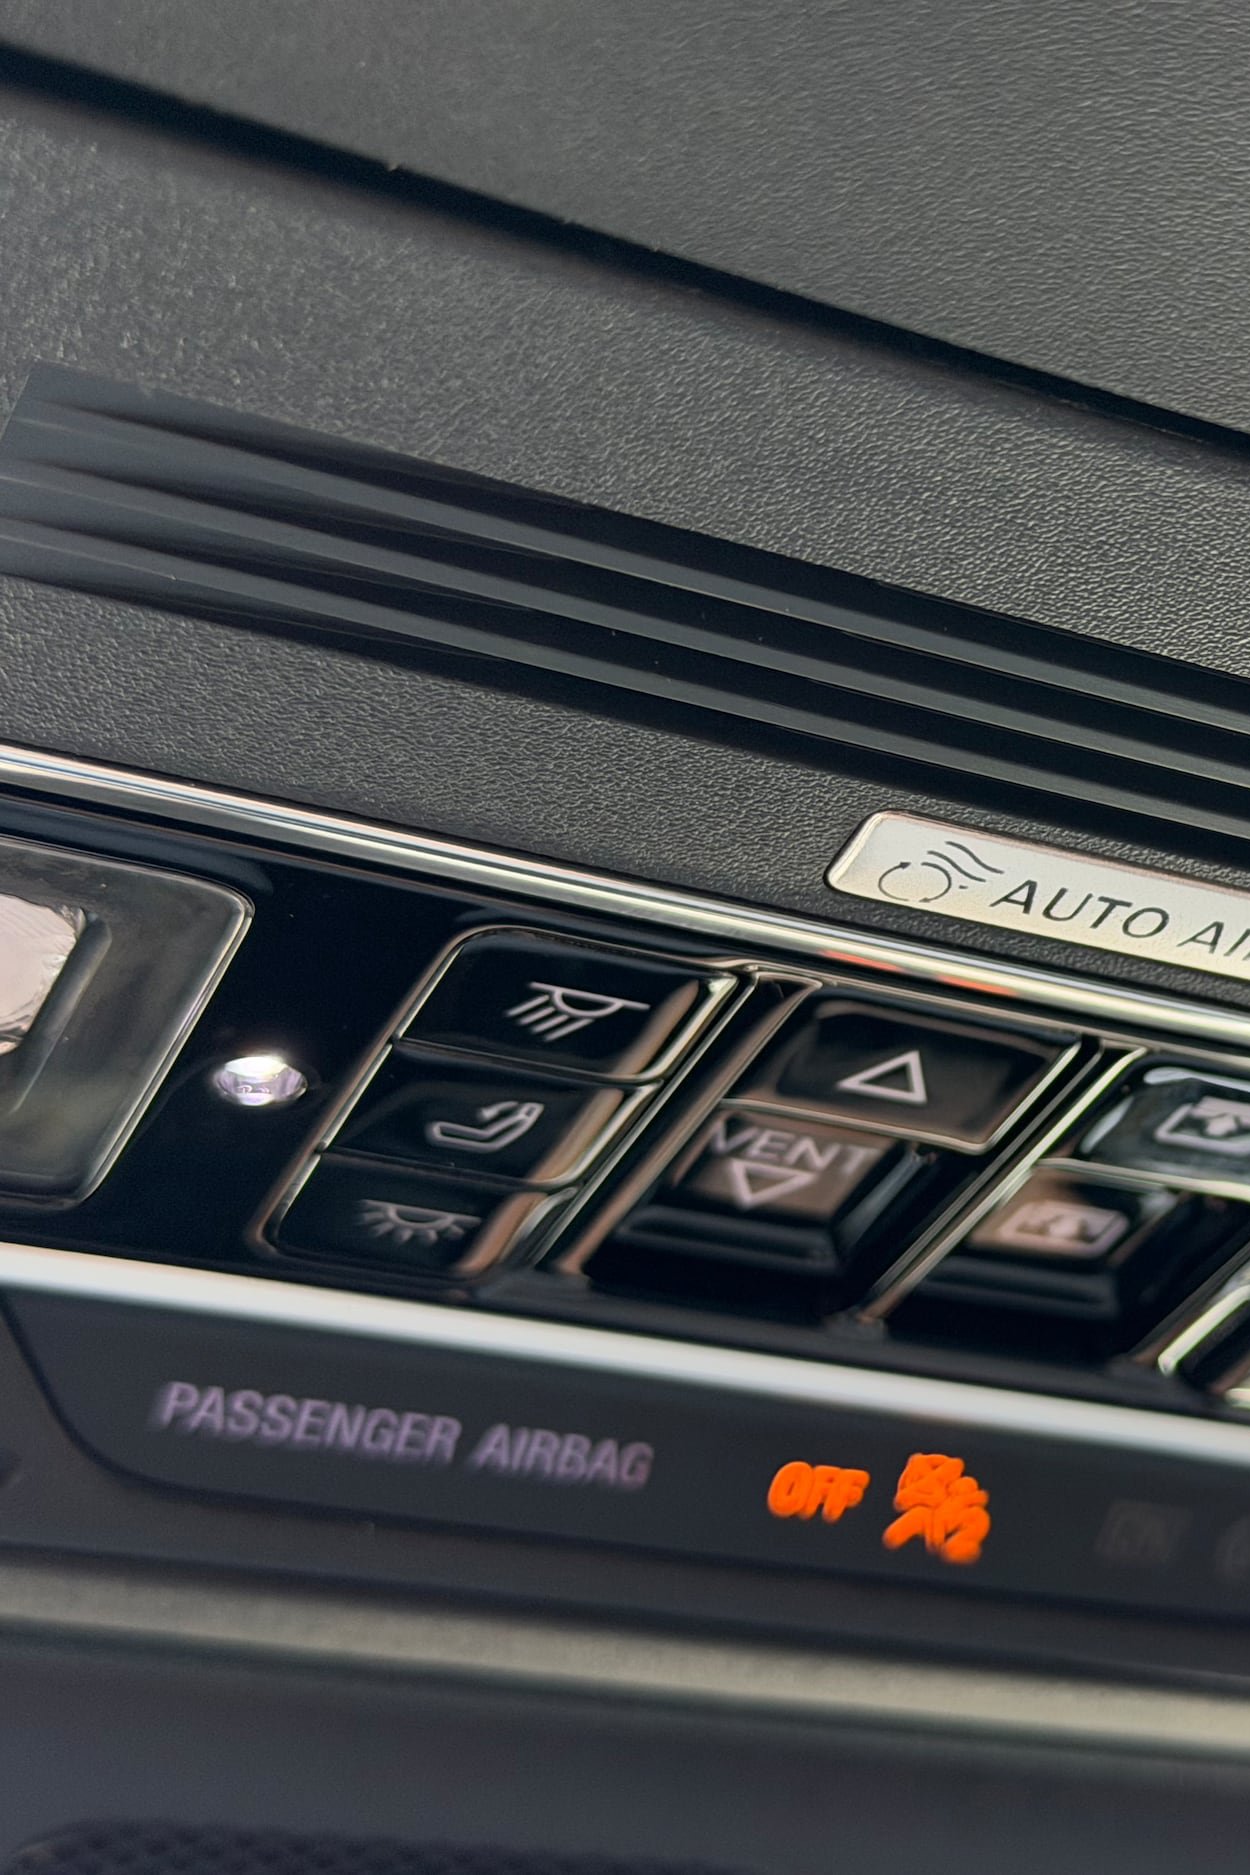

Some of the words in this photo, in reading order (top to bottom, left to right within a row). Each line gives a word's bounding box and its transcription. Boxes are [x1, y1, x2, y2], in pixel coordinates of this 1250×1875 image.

[989, 878, 1169, 940] AUTO
[711, 1116, 884, 1175] VENT
[151, 1380, 463, 1464] PASSENGER
[470, 1422, 656, 1490] AIRBAG
[767, 1460, 871, 1523] OFF
